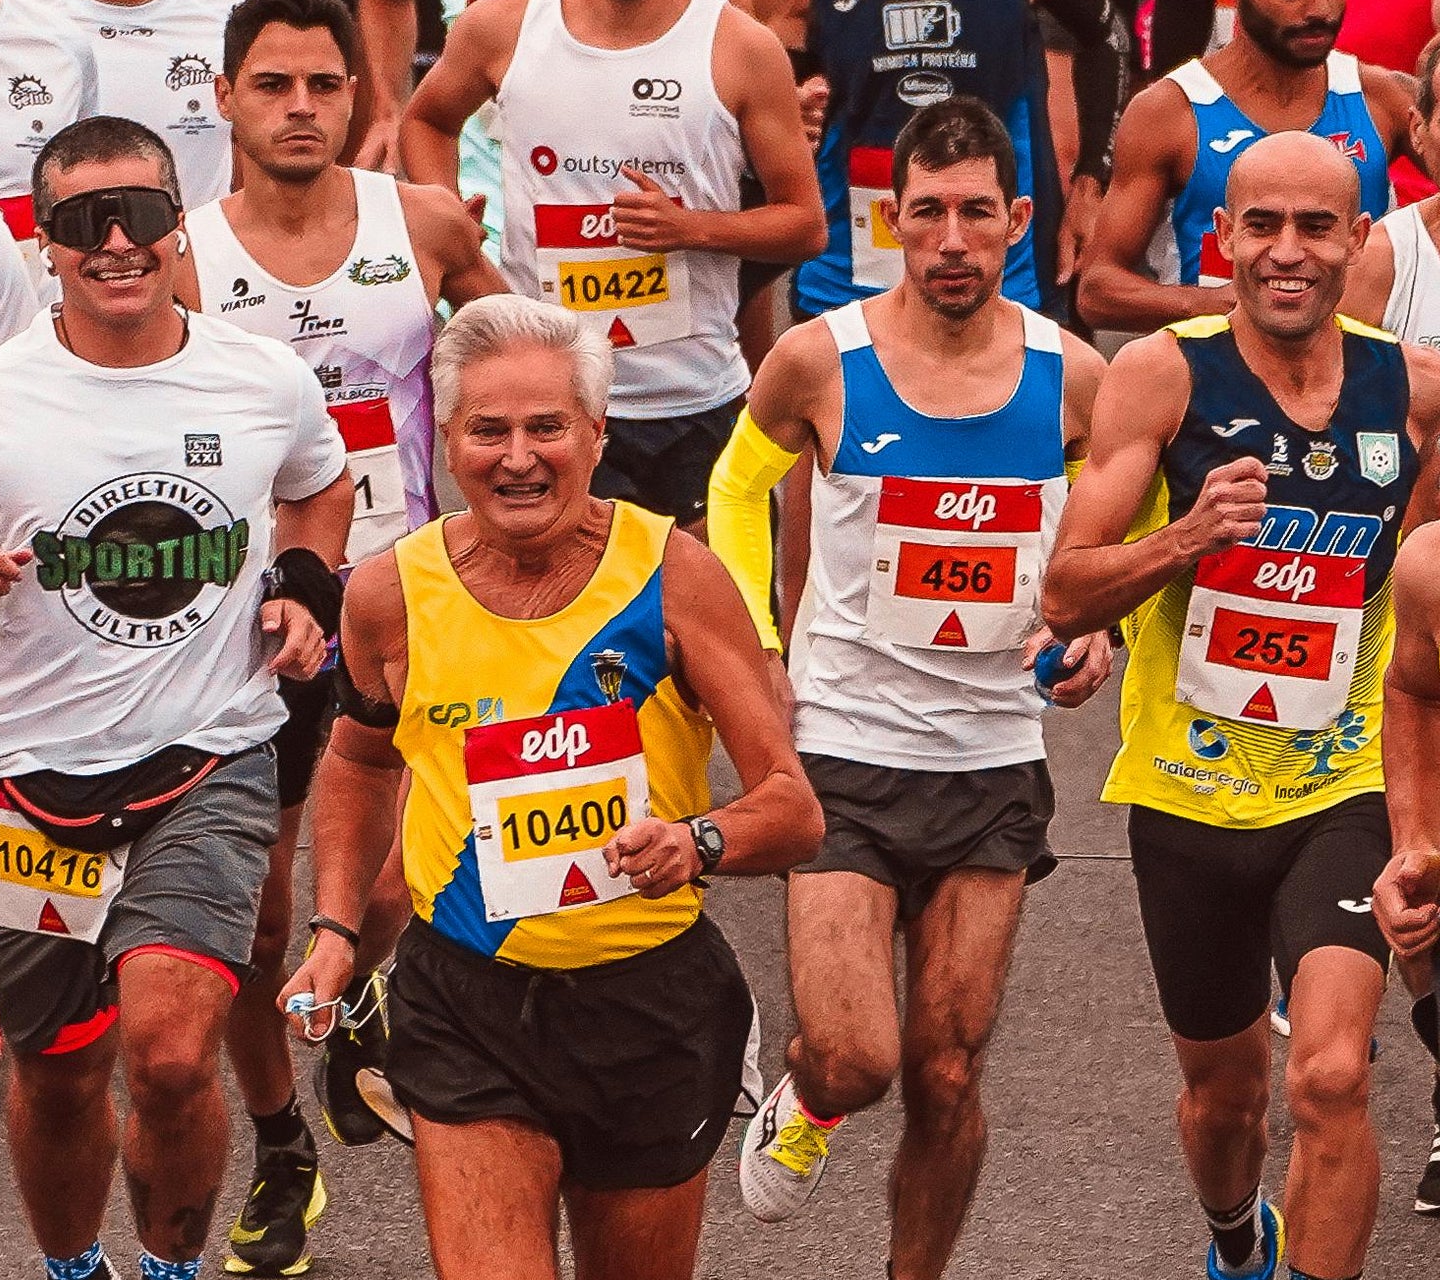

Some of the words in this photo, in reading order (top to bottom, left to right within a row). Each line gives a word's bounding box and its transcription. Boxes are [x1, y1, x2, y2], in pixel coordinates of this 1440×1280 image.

[220, 293, 267, 313] VIATOR
[562, 265, 668, 304] 10422
[74, 479, 214, 528] DIRECTIVO
[934, 485, 997, 531] edp
[921, 558, 992, 594] 456
[1252, 556, 1317, 602] edp
[89, 607, 203, 642] ULTRAS
[1233, 627, 1309, 668] 255
[520, 716, 591, 767] edp
[502, 794, 628, 850] 10400
